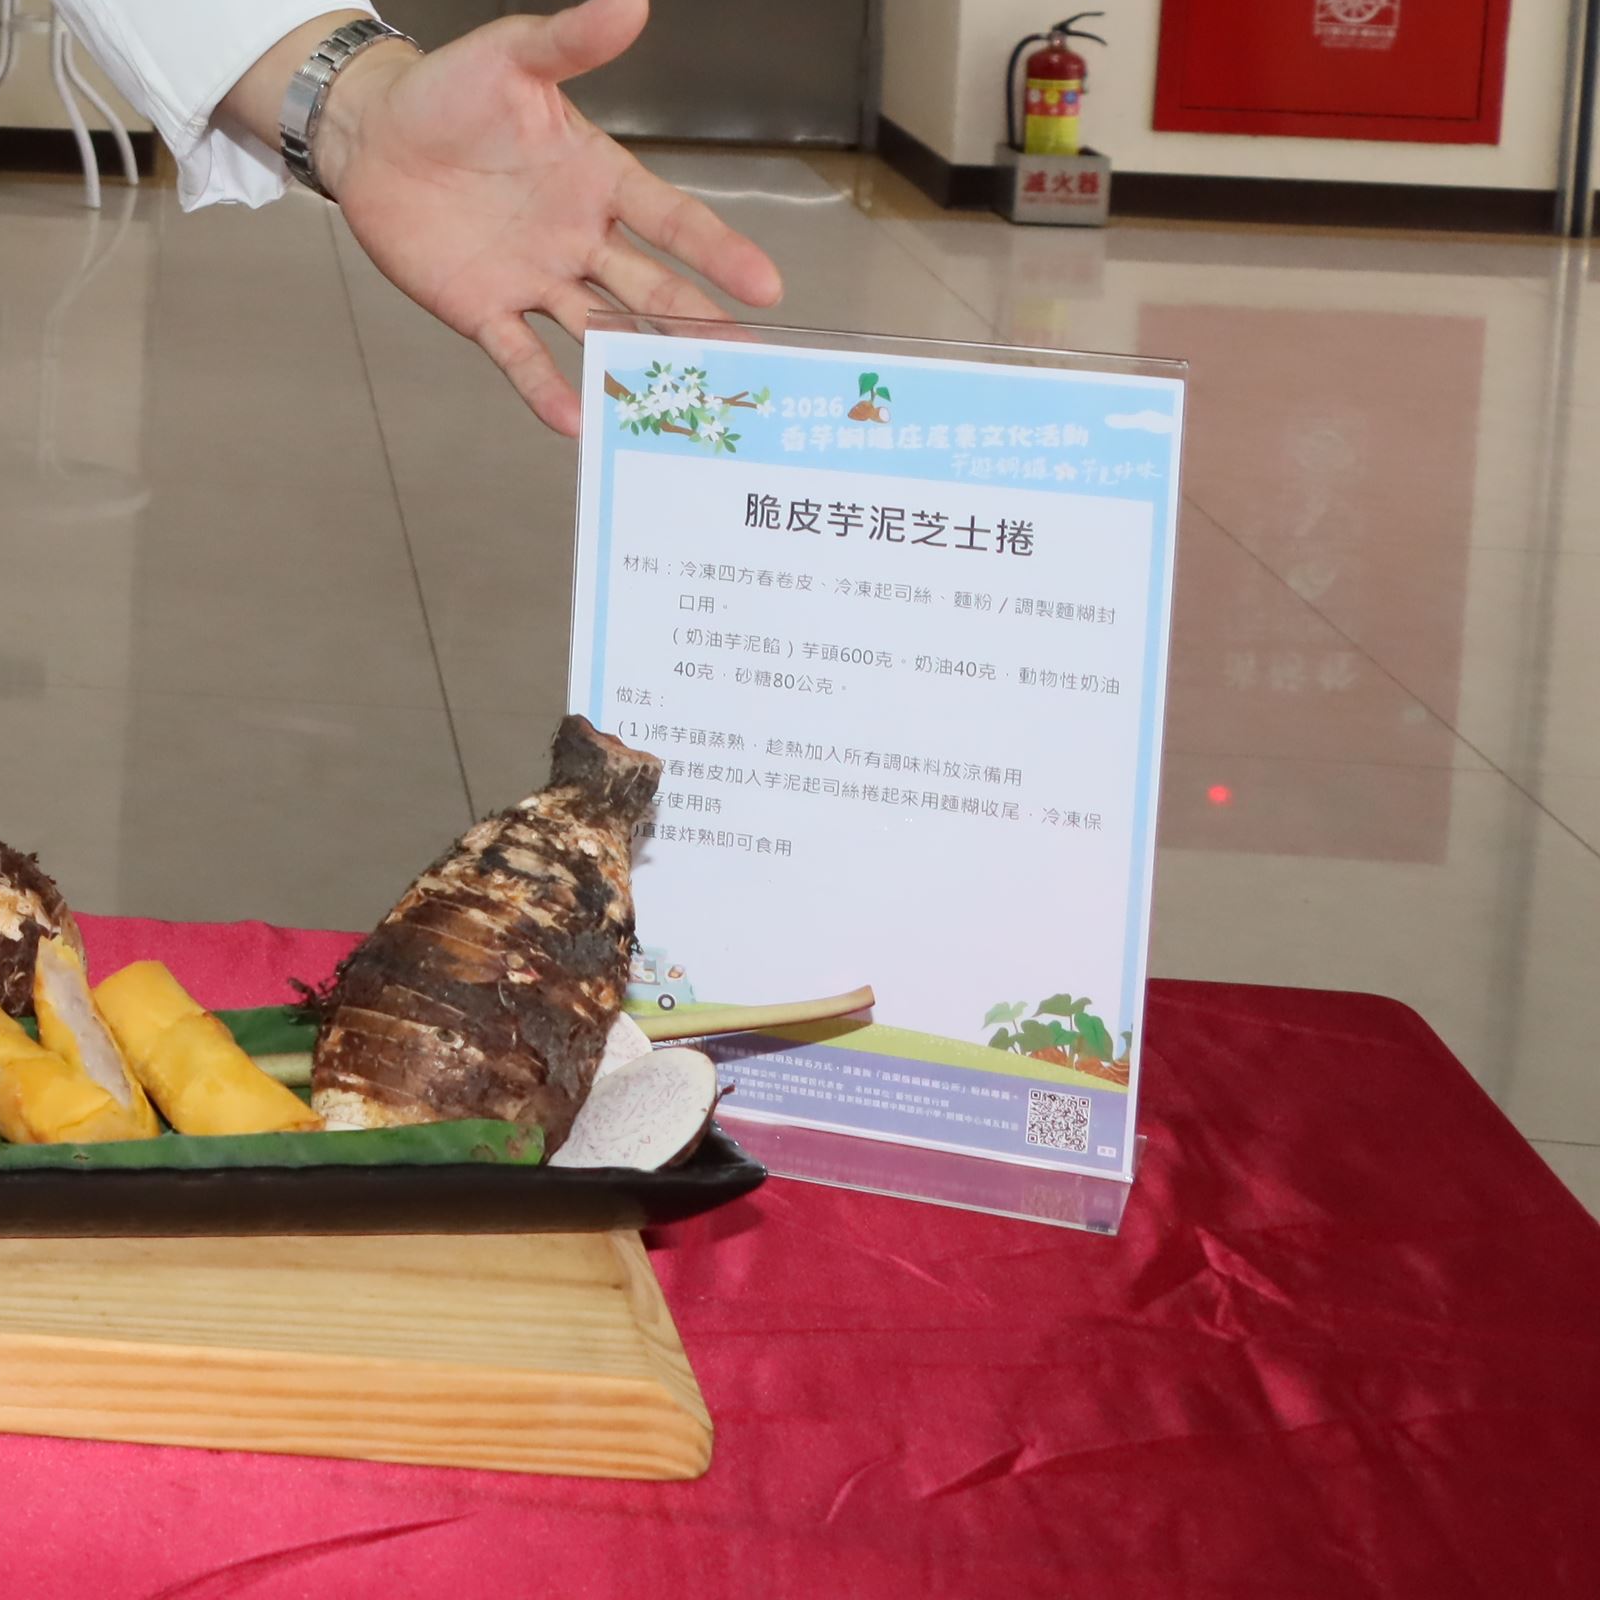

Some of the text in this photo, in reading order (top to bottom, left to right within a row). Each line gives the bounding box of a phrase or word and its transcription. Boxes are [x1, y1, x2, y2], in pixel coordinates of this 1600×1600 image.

[780, 396, 845, 418] 2026
[743, 492, 1036, 558] 脆皮芋泥芝士捲
